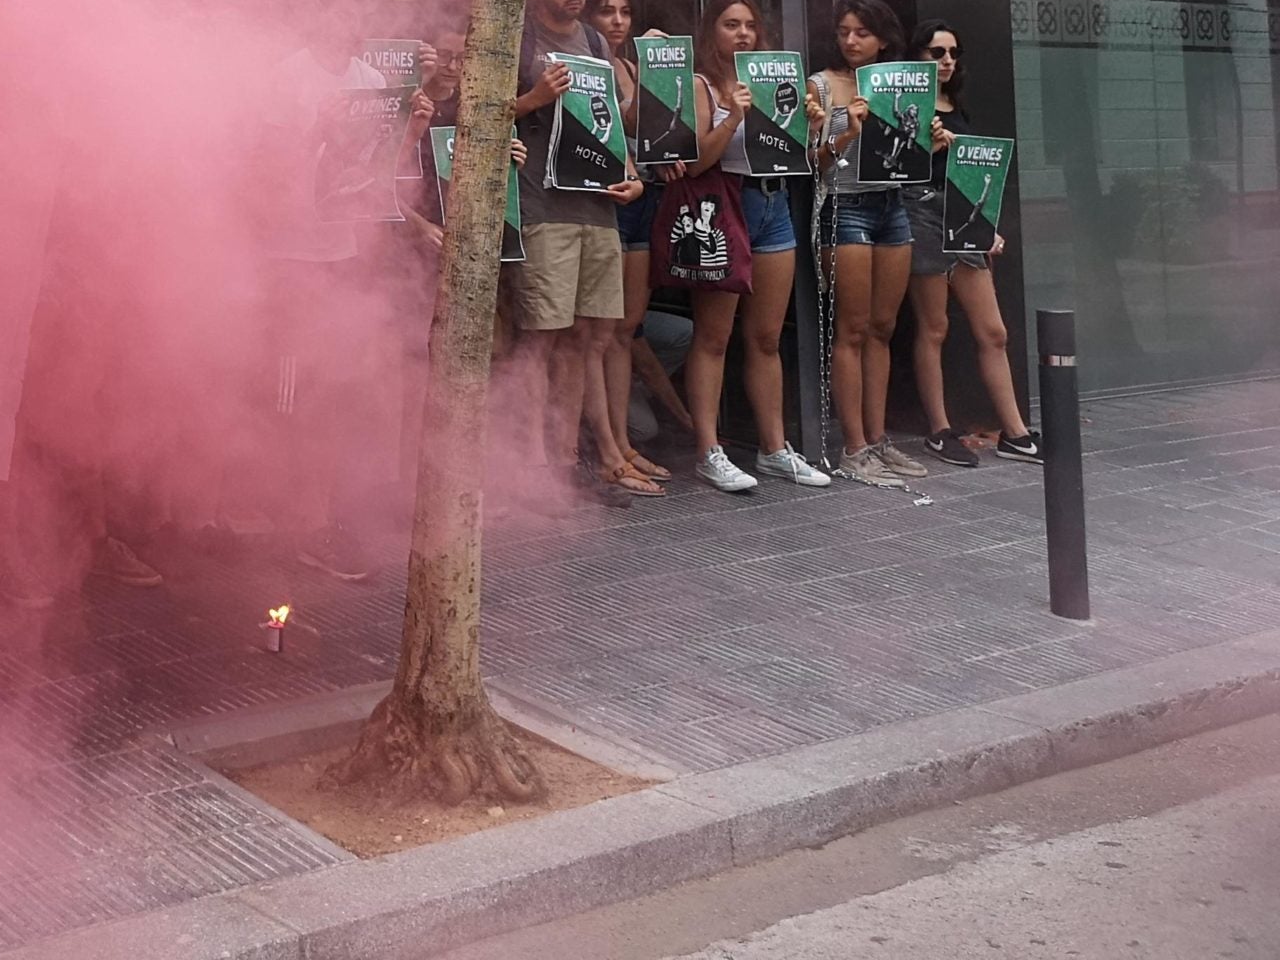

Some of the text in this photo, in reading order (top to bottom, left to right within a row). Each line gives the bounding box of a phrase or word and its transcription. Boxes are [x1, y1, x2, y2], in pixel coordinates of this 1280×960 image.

[363, 51, 372, 66] O
[647, 47, 654, 62] O
[748, 62, 758, 76] O
[870, 73, 881, 86] O
[759, 132, 791, 153] HOTEL
[574, 144, 608, 169] HOTEL
[957, 145, 966, 159] O
